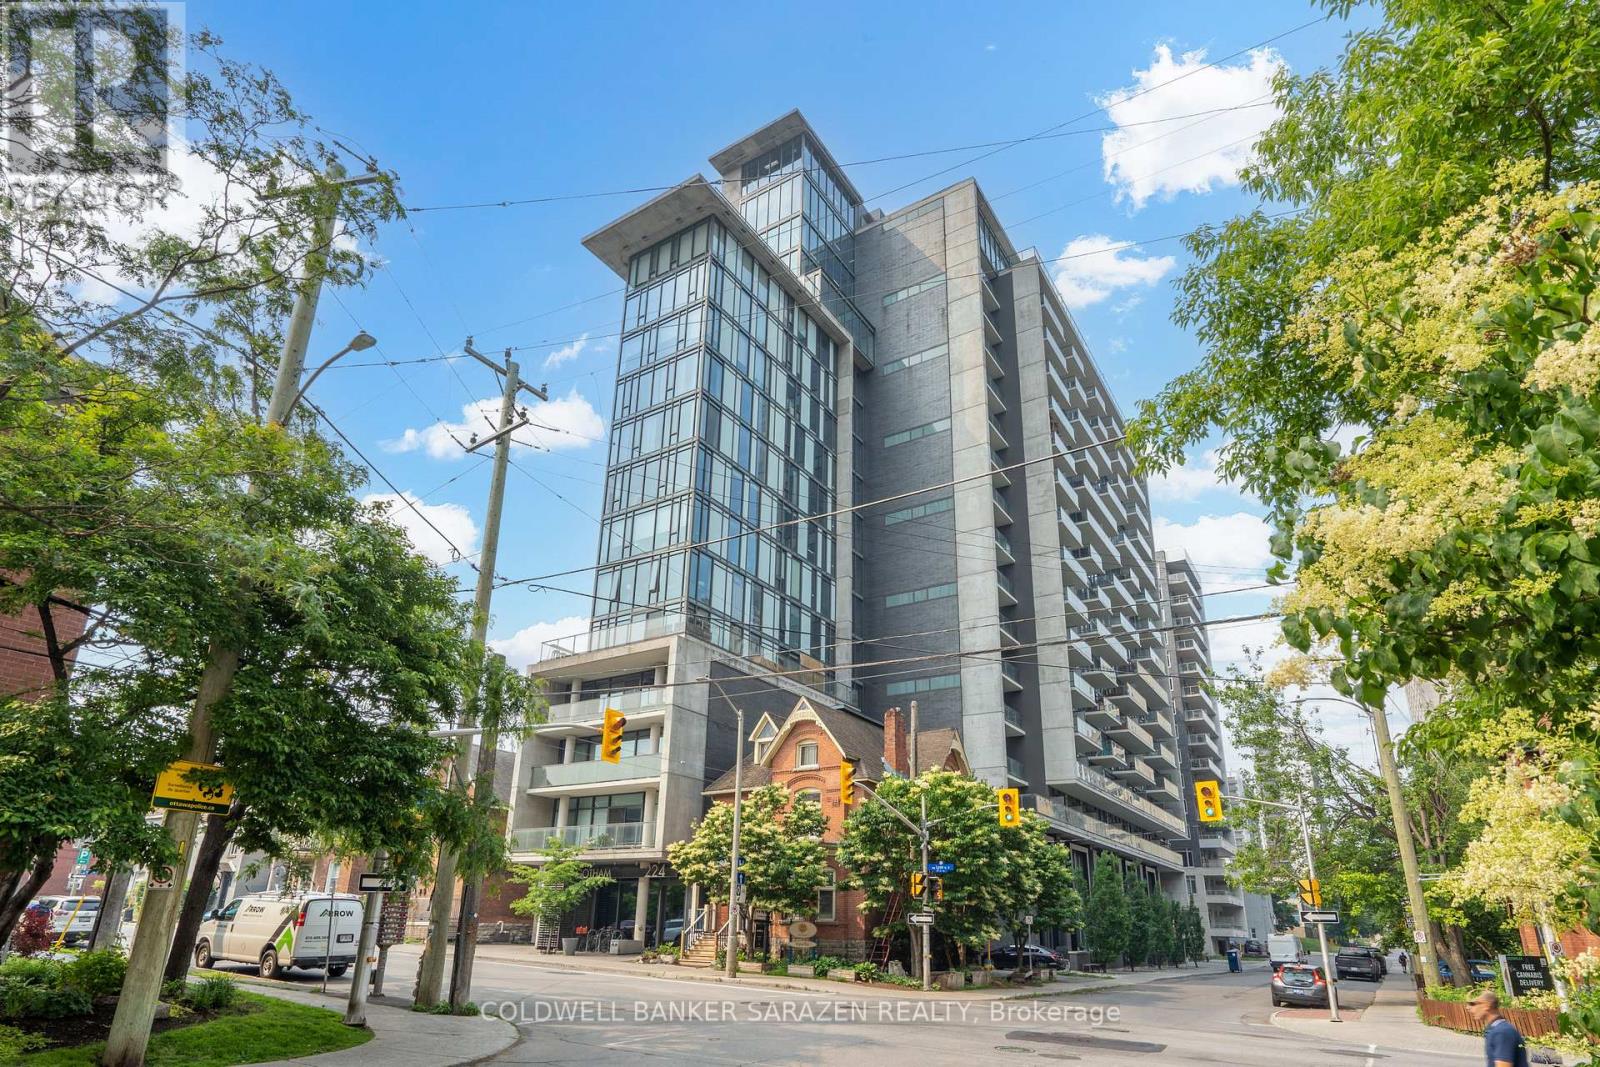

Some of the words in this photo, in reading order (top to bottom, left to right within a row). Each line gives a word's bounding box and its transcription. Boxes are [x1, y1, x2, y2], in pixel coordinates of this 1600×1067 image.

[644, 863, 666, 878] 224
[320, 908, 354, 918] ARROW
[1521, 963, 1536, 971] FREE
[1515, 971, 1543, 979] CANNABIS
[1519, 979, 1544, 987] DELIVERY
